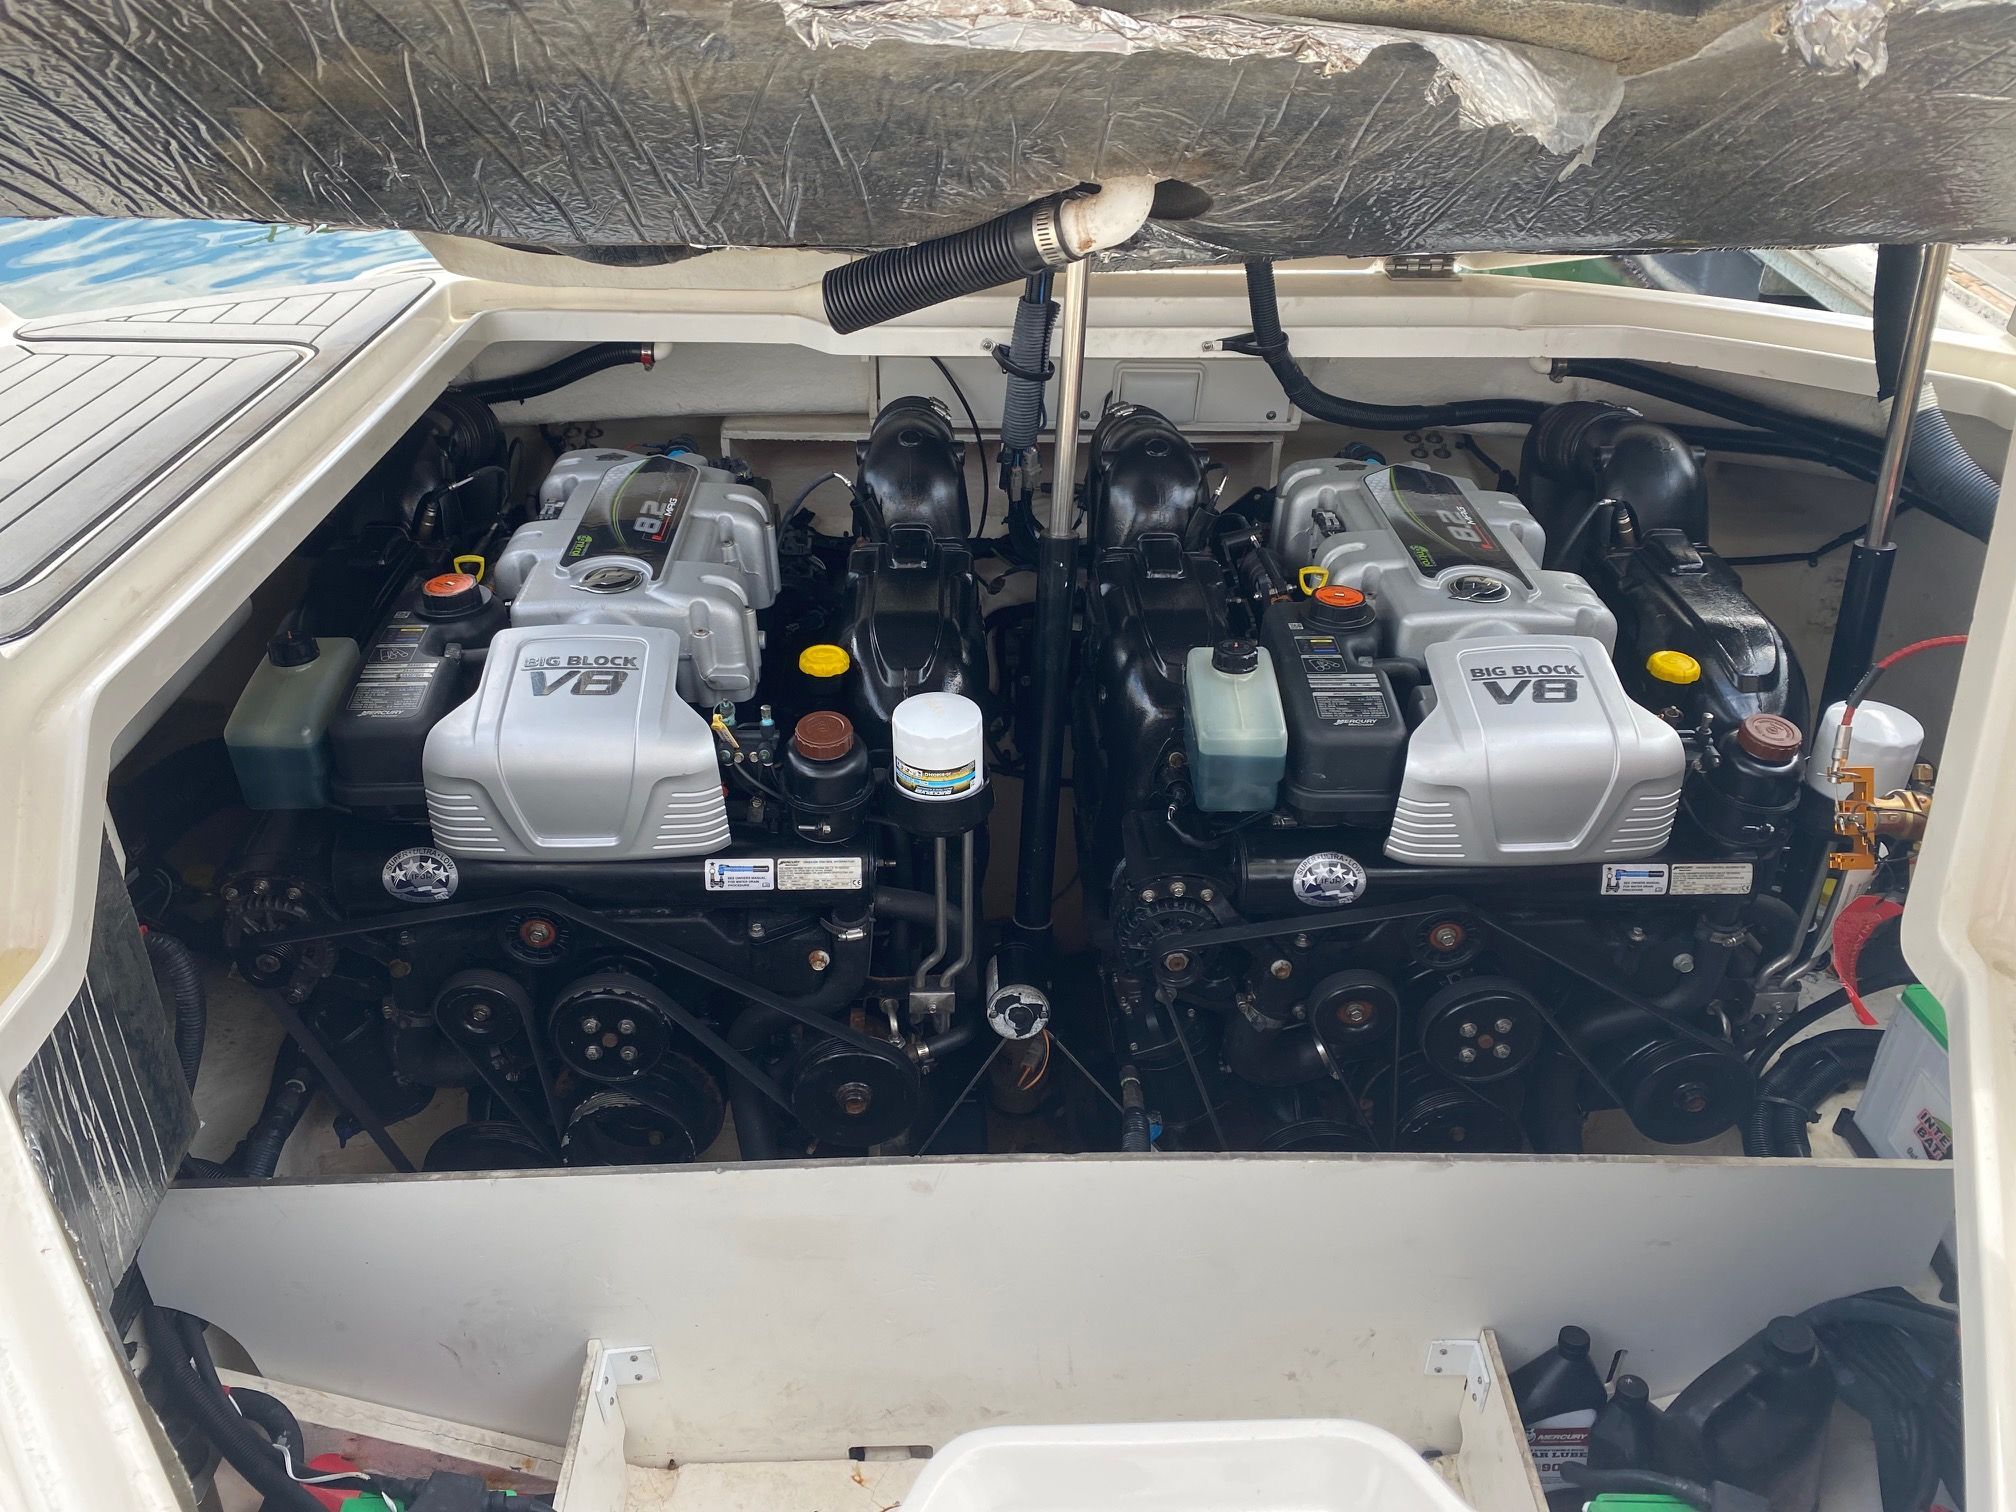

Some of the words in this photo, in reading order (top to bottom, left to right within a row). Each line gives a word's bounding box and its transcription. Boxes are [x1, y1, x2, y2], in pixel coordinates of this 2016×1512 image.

[524, 656, 561, 667] BIG
[566, 655, 638, 667] BLOCK
[1470, 666, 1507, 678] BIG
[1512, 664, 1580, 675] BLOCK
[530, 670, 629, 697] V8
[1482, 679, 1578, 705] V8
[386, 851, 409, 870] SUPER
[413, 848, 437, 857] ULTRA
[440, 857, 455, 870] LOW
[1297, 856, 1318, 876] SUPER
[1320, 853, 1344, 862] ULTRA
[1348, 860, 1363, 875] LOW
[1921, 1111, 1950, 1148] INTE
